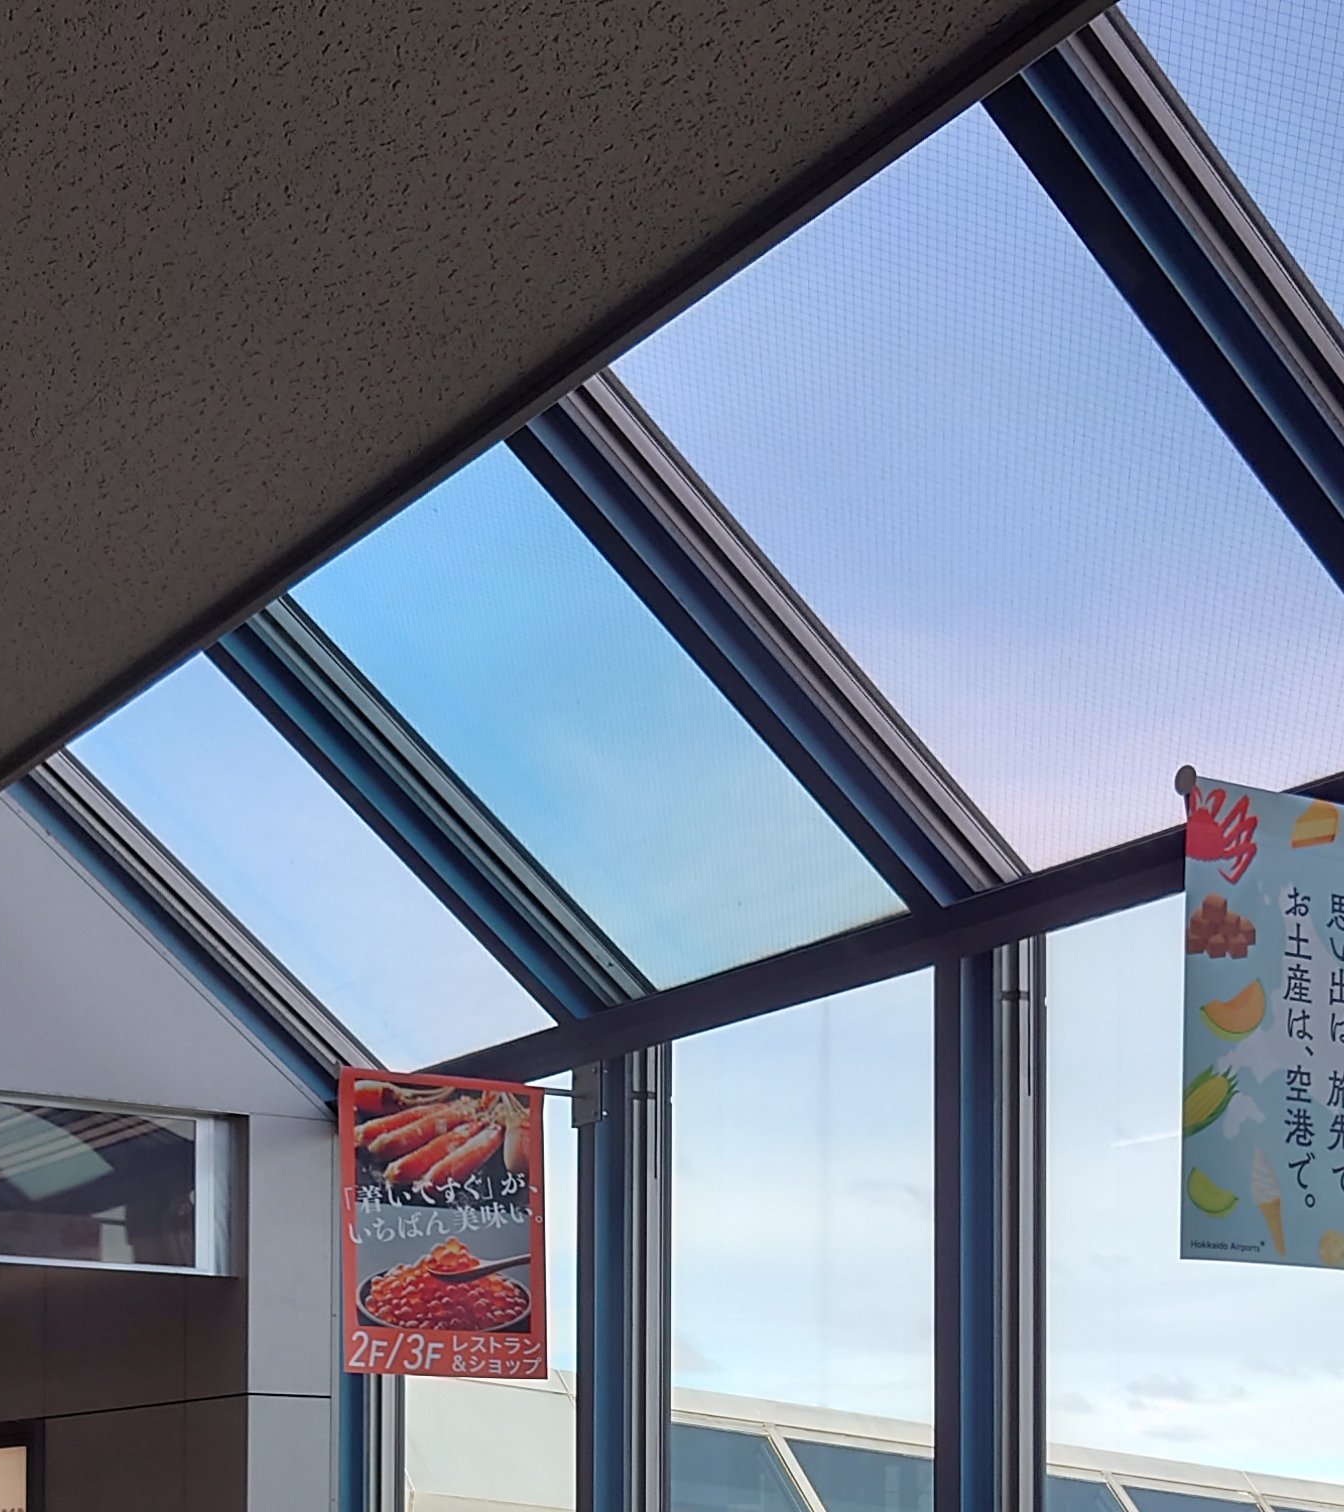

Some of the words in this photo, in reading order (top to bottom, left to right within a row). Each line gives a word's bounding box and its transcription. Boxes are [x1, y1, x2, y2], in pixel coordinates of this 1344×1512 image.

[1282, 885, 1317, 1211] お土産は、空港で。
[342, 1172, 539, 1213] 「着いてすぐ」が、
[348, 1202, 545, 1245] いちばん美味い。
[1190, 1240, 1228, 1250] Hokkaido
[1229, 1242, 1260, 1252] Airports
[348, 1330, 445, 1370] 2F/3F
[451, 1354, 541, 1375] &ショップ
[452, 1334, 541, 1355] レストラン
